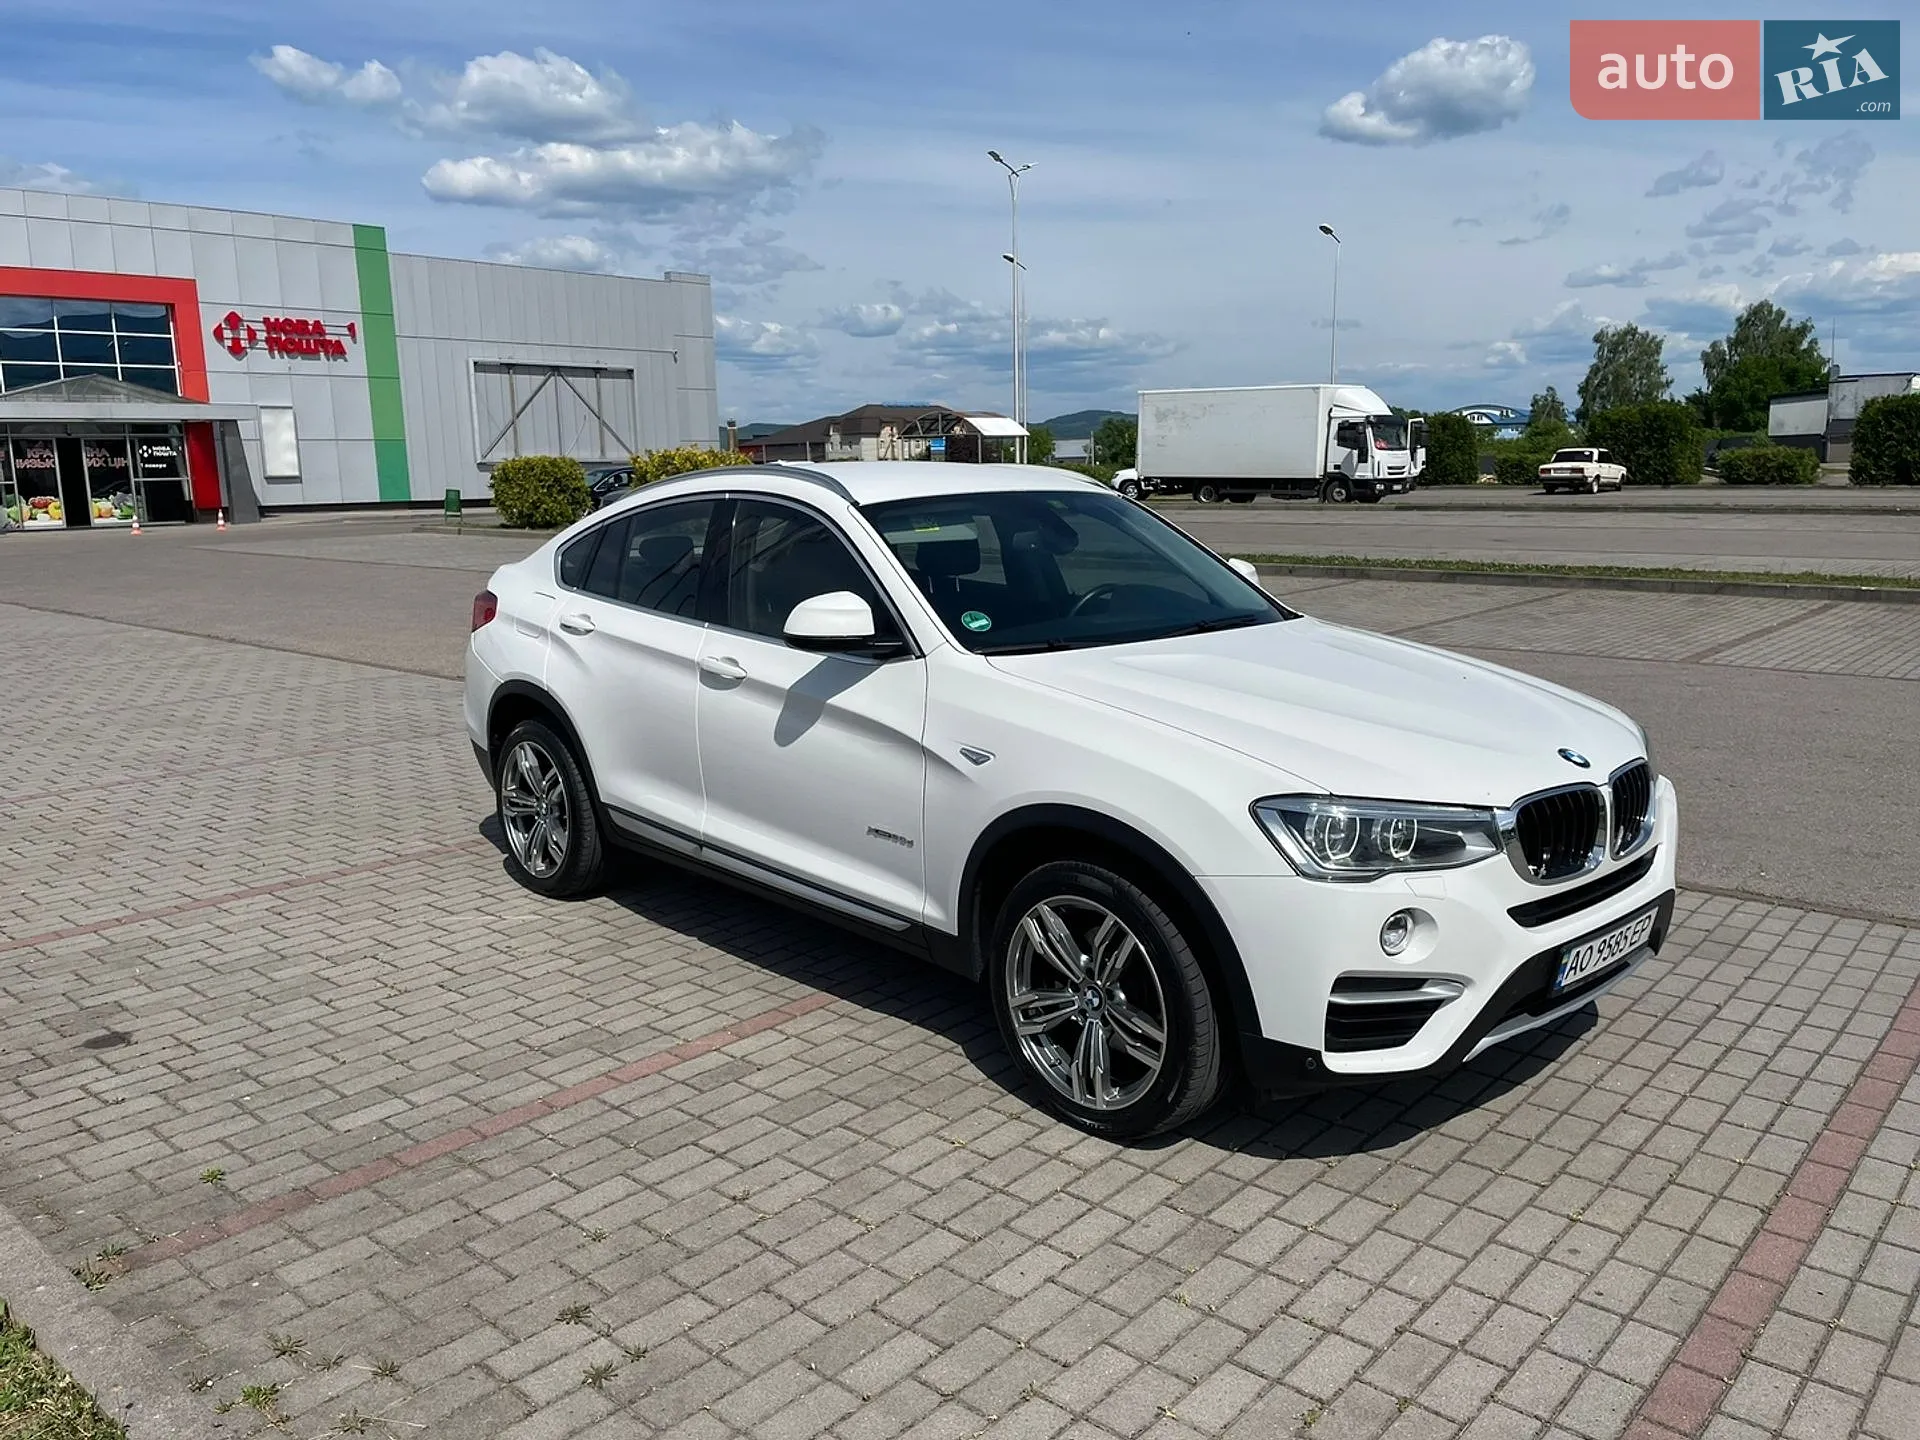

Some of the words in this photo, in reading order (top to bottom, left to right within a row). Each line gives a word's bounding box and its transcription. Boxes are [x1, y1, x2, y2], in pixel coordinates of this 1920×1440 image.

[262, 317, 326, 338] НОВА
[265, 336, 347, 357] ПОШТА
[1564, 945, 1593, 980] AO
[1593, 926, 1631, 967] 9585
[1629, 914, 1652, 946] EP
